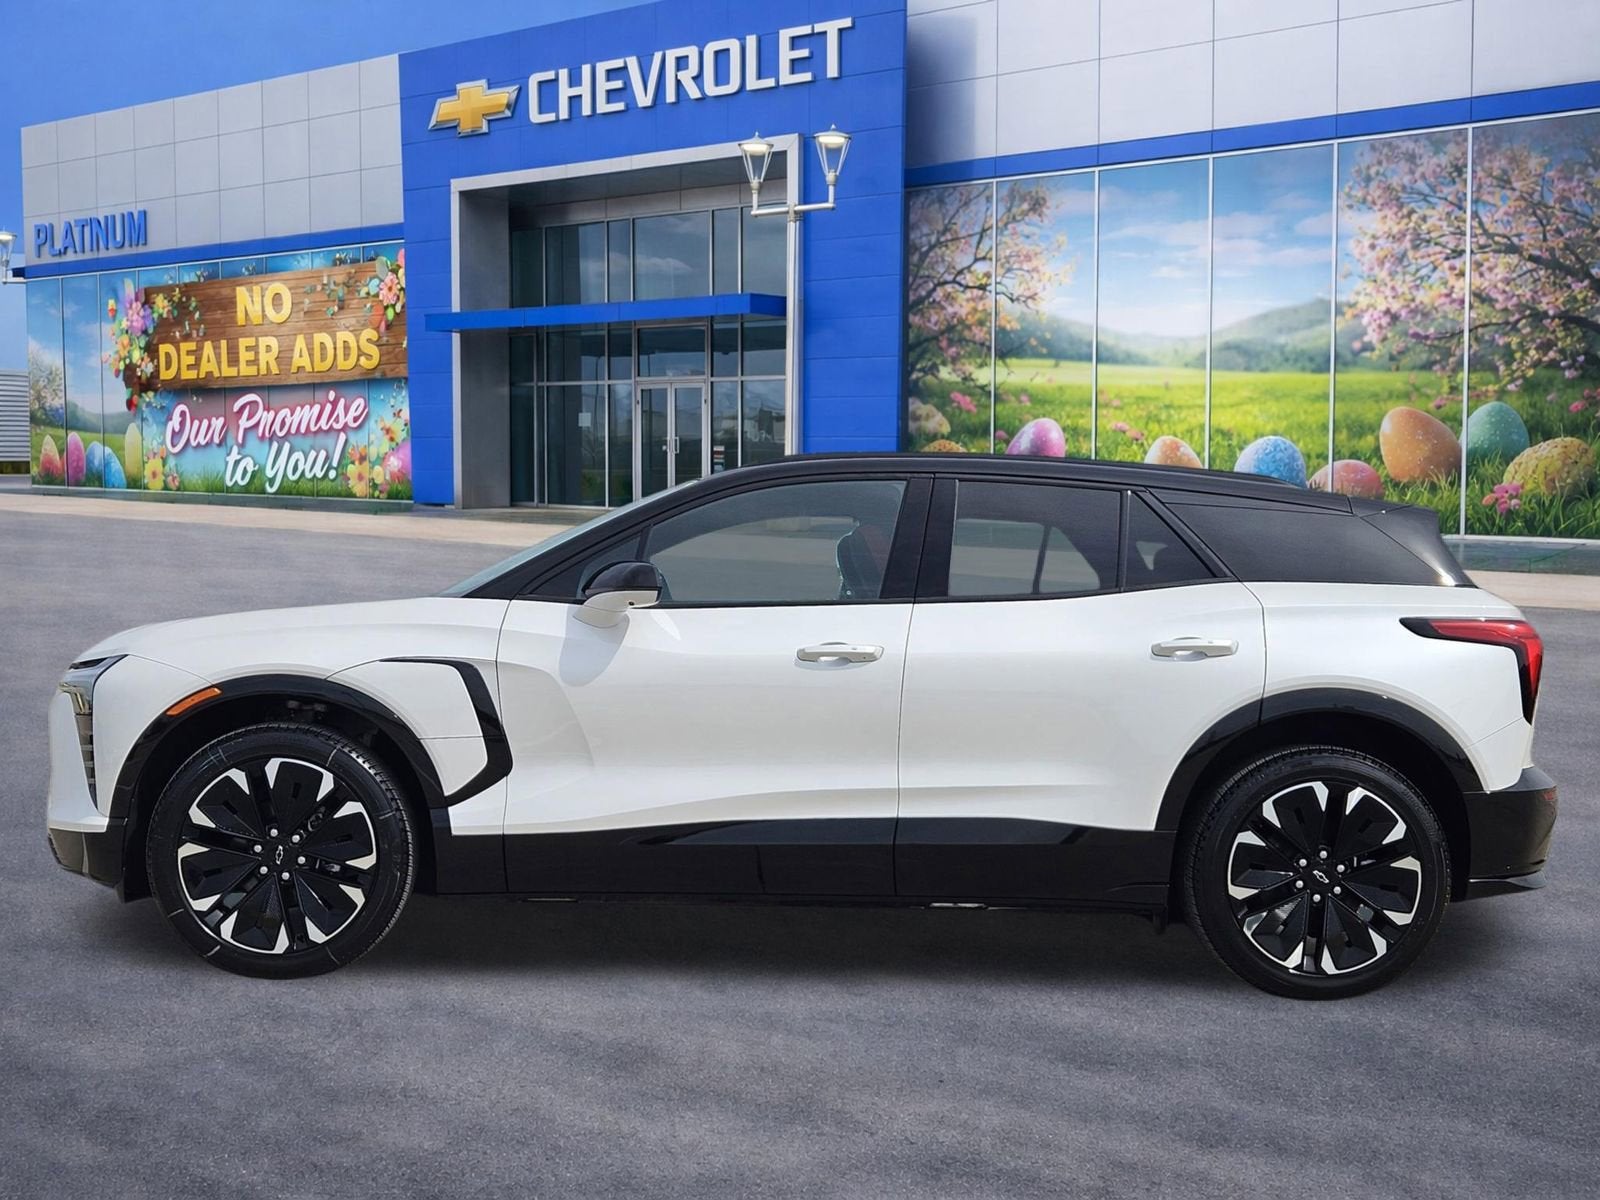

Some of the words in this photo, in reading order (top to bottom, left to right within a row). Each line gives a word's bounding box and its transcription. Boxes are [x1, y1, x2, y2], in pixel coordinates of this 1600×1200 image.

[528, 17, 853, 124] CHEVROLET
[34, 209, 147, 257] PLATINUM
[236, 283, 292, 325] NO
[158, 336, 279, 380] DEALER
[290, 329, 380, 373] ADDS
[166, 404, 227, 454] Our
[234, 390, 368, 443] Promise
[225, 448, 257, 487] to
[265, 433, 346, 493] You!
